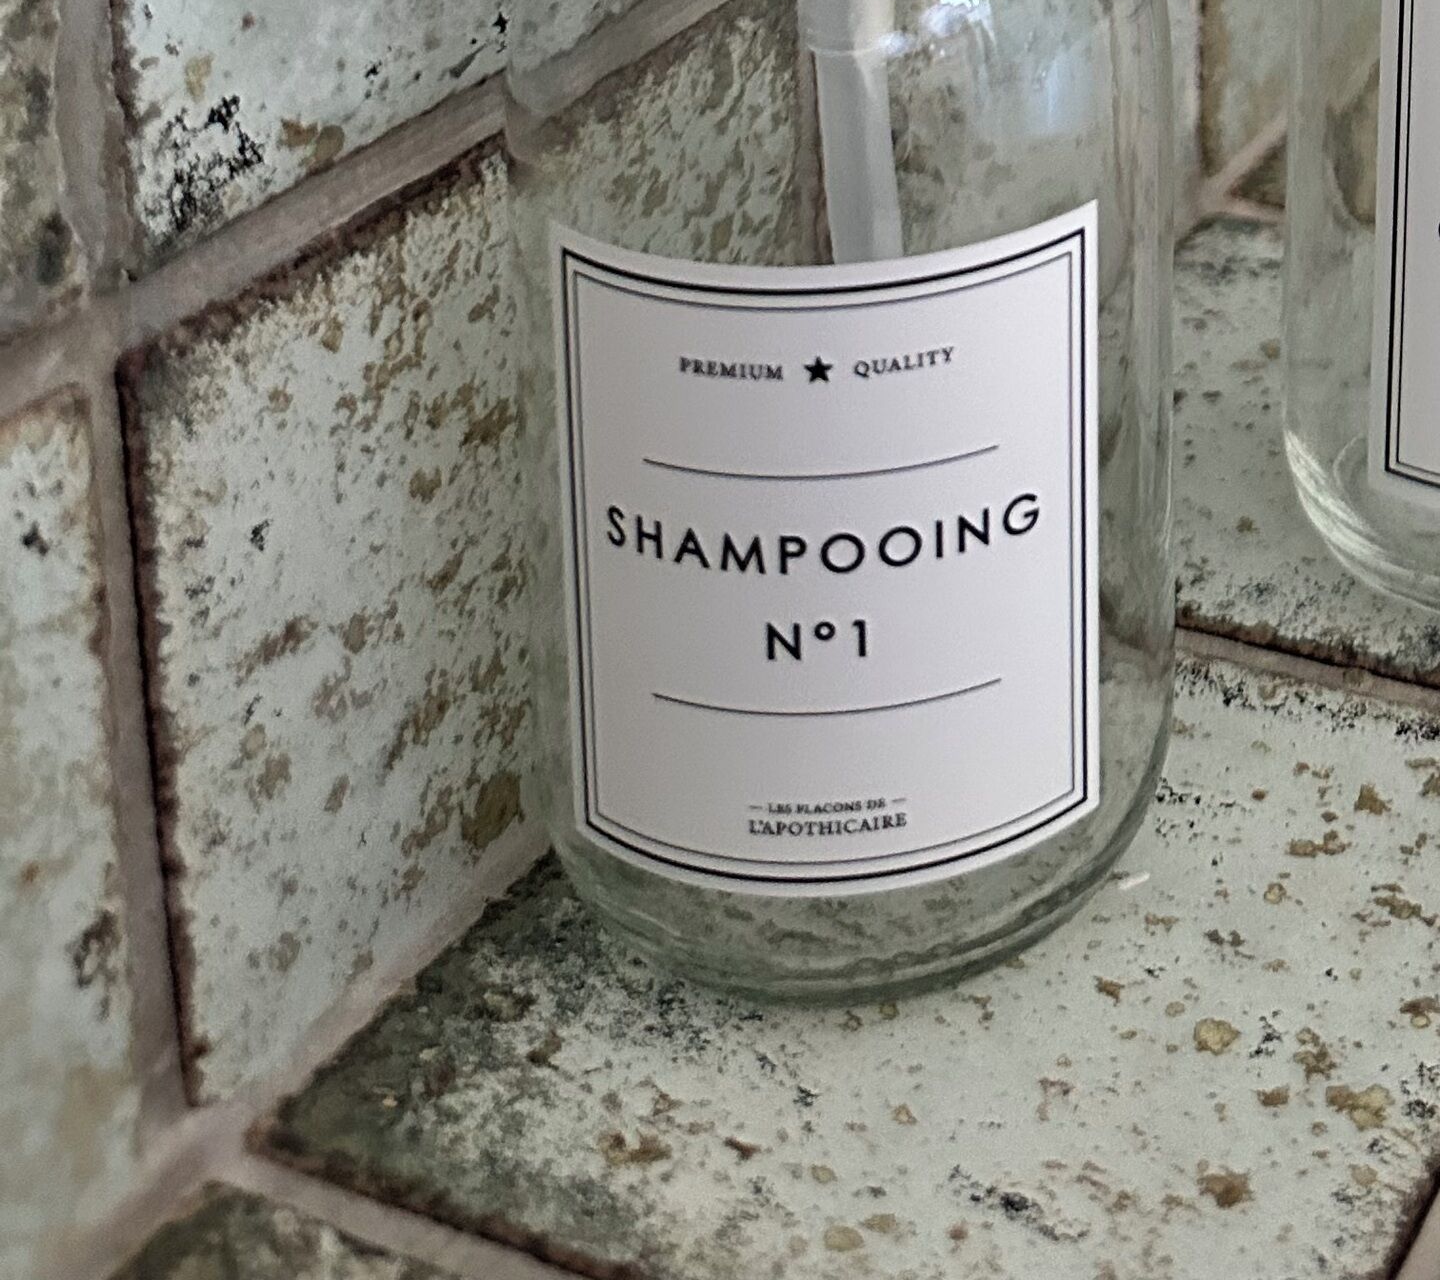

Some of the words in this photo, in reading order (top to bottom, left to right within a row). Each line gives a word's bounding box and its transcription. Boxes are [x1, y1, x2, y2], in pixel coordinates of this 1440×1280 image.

[680, 357, 784, 380] PREMIUM
[854, 346, 954, 378] QUALITY
[606, 493, 1040, 575] SHAMPOOING
[766, 619, 867, 661] N°1
[768, 803, 792, 813] LES
[796, 801, 862, 814] FLACONS
[867, 797, 885, 810] DE
[749, 813, 907, 836] L'APOTHICAIRE
